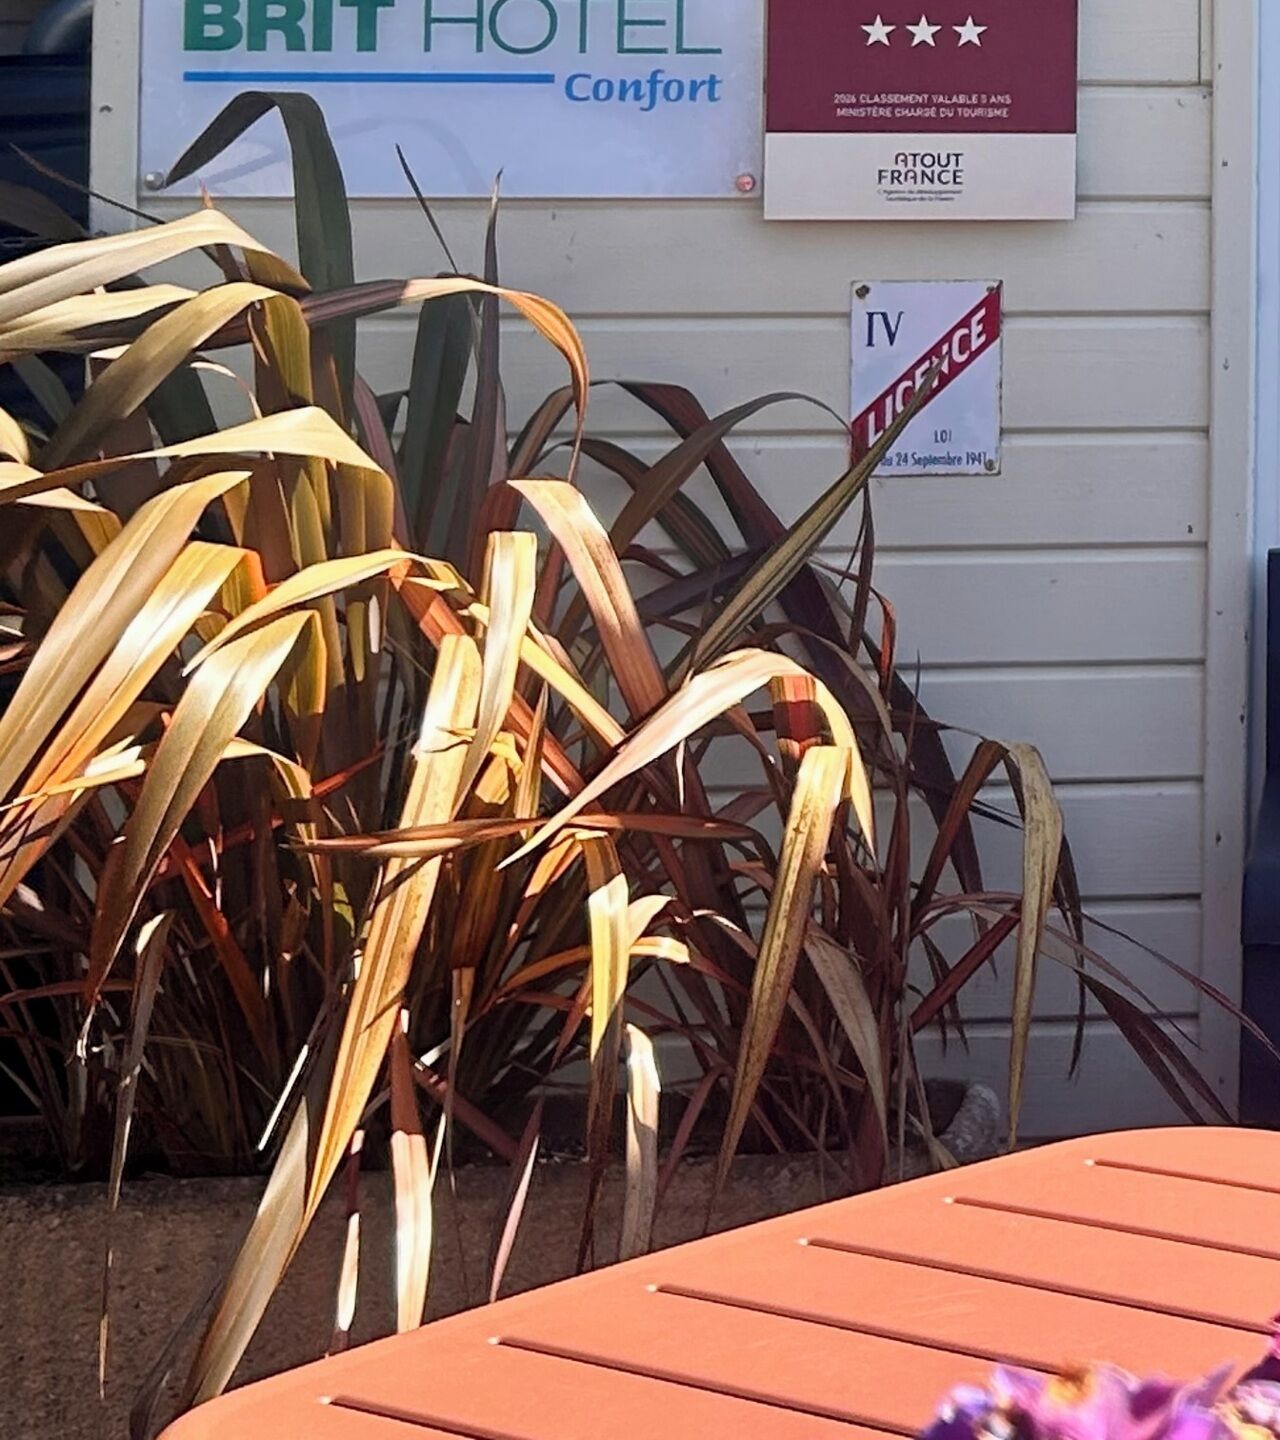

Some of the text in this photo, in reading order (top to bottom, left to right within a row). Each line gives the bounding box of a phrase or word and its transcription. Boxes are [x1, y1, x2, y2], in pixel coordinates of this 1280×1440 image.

[564, 68, 722, 109] Confort
[859, 93, 928, 104] CLASSEMENT
[932, 94, 978, 105] VALABLE
[989, 94, 1013, 105] ANS
[836, 106, 1009, 119] MINISTÈRE CHARGÉ DU TOURISME
[894, 152, 964, 169] ATOUT
[878, 169, 964, 185] FRANCE
[866, 310, 905, 348] IV
[934, 429, 953, 444] LOI
[895, 452, 908, 467] 24
[911, 451, 963, 469] Septembre
